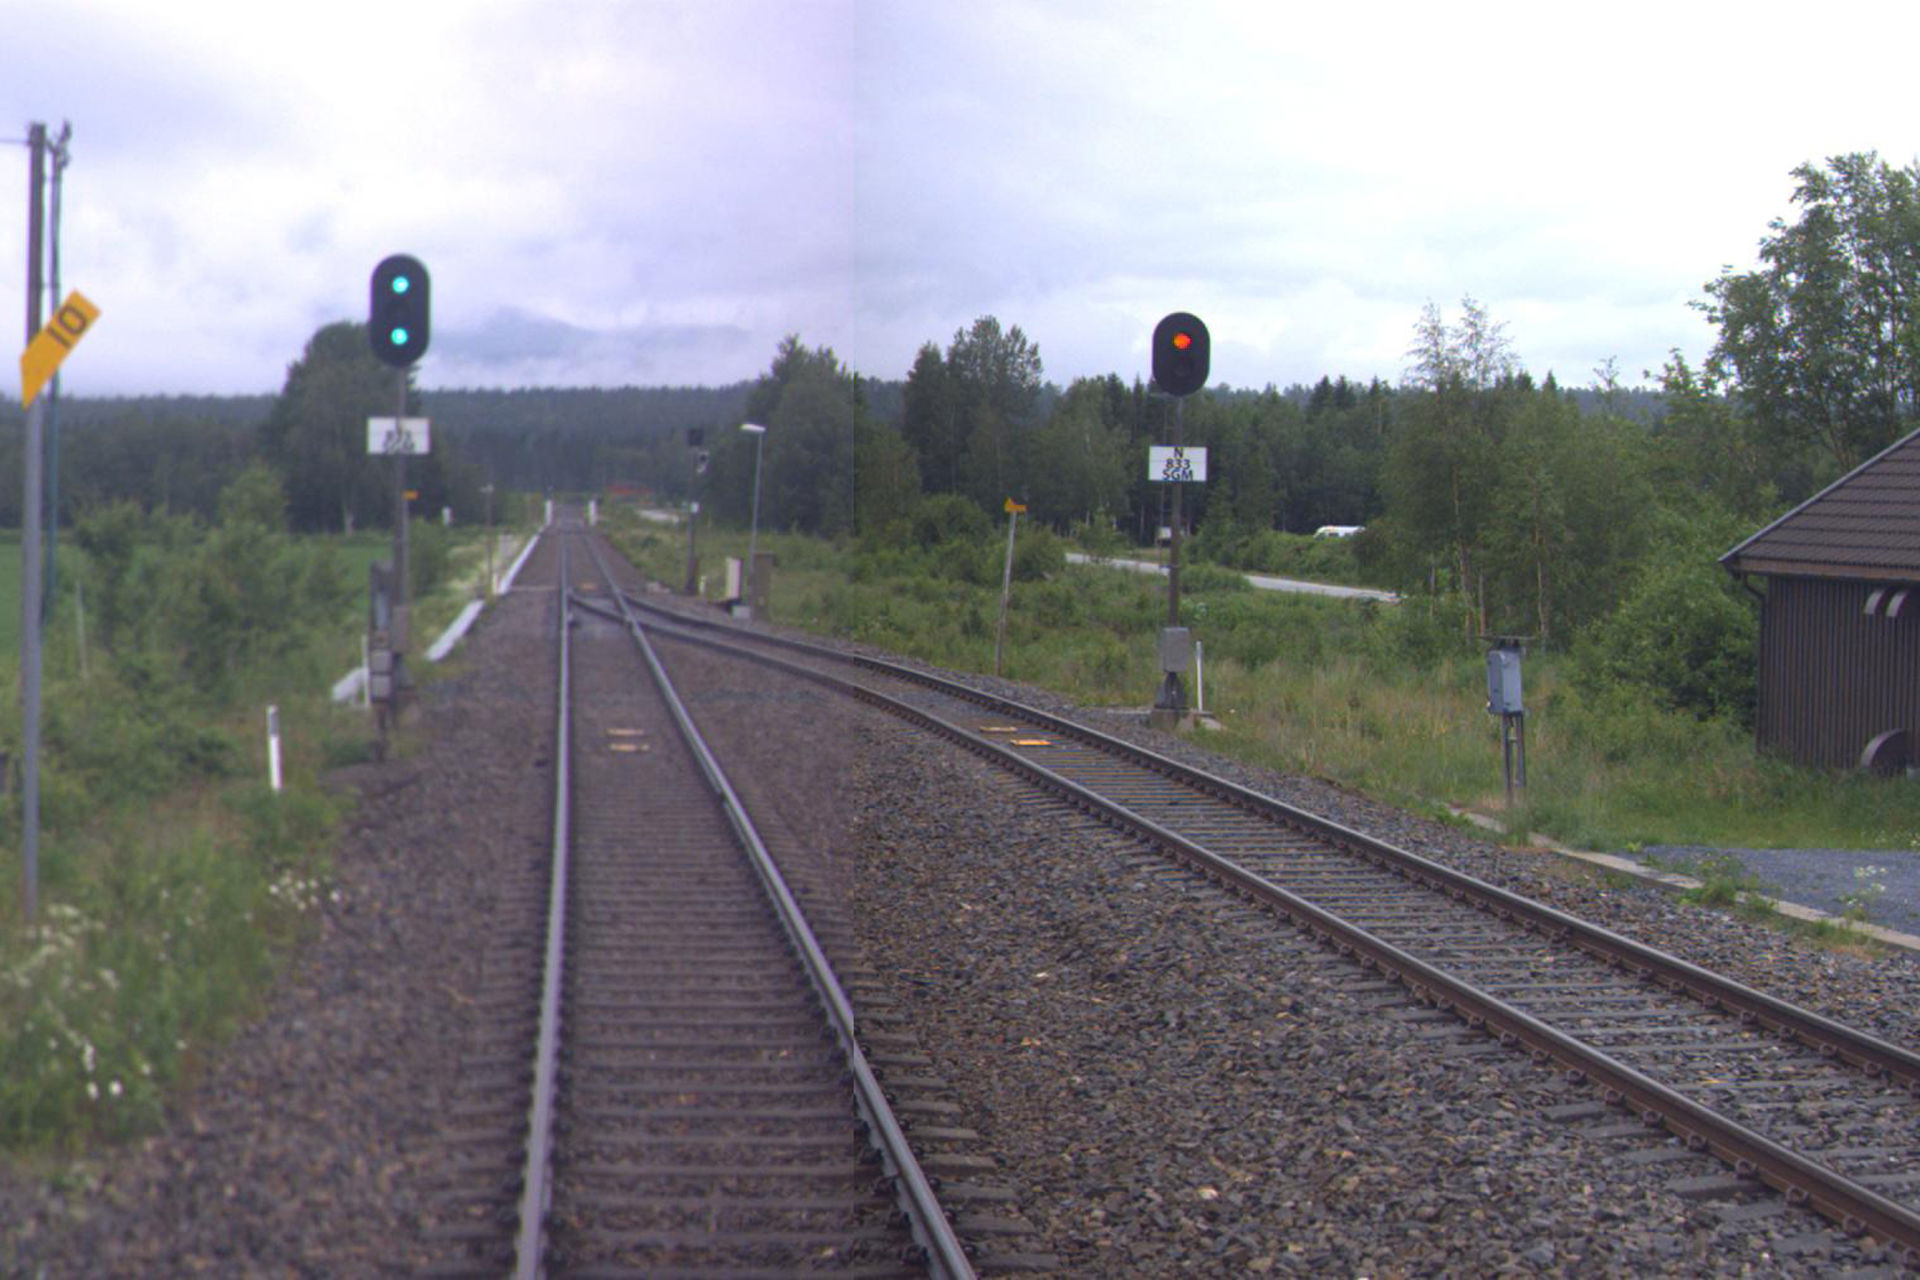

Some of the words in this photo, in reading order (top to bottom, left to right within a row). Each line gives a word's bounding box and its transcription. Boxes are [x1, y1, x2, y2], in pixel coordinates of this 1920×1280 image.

[47, 304, 88, 350] 10
[1174, 447, 1184, 458] N
[1162, 469, 1194, 481] SGM
